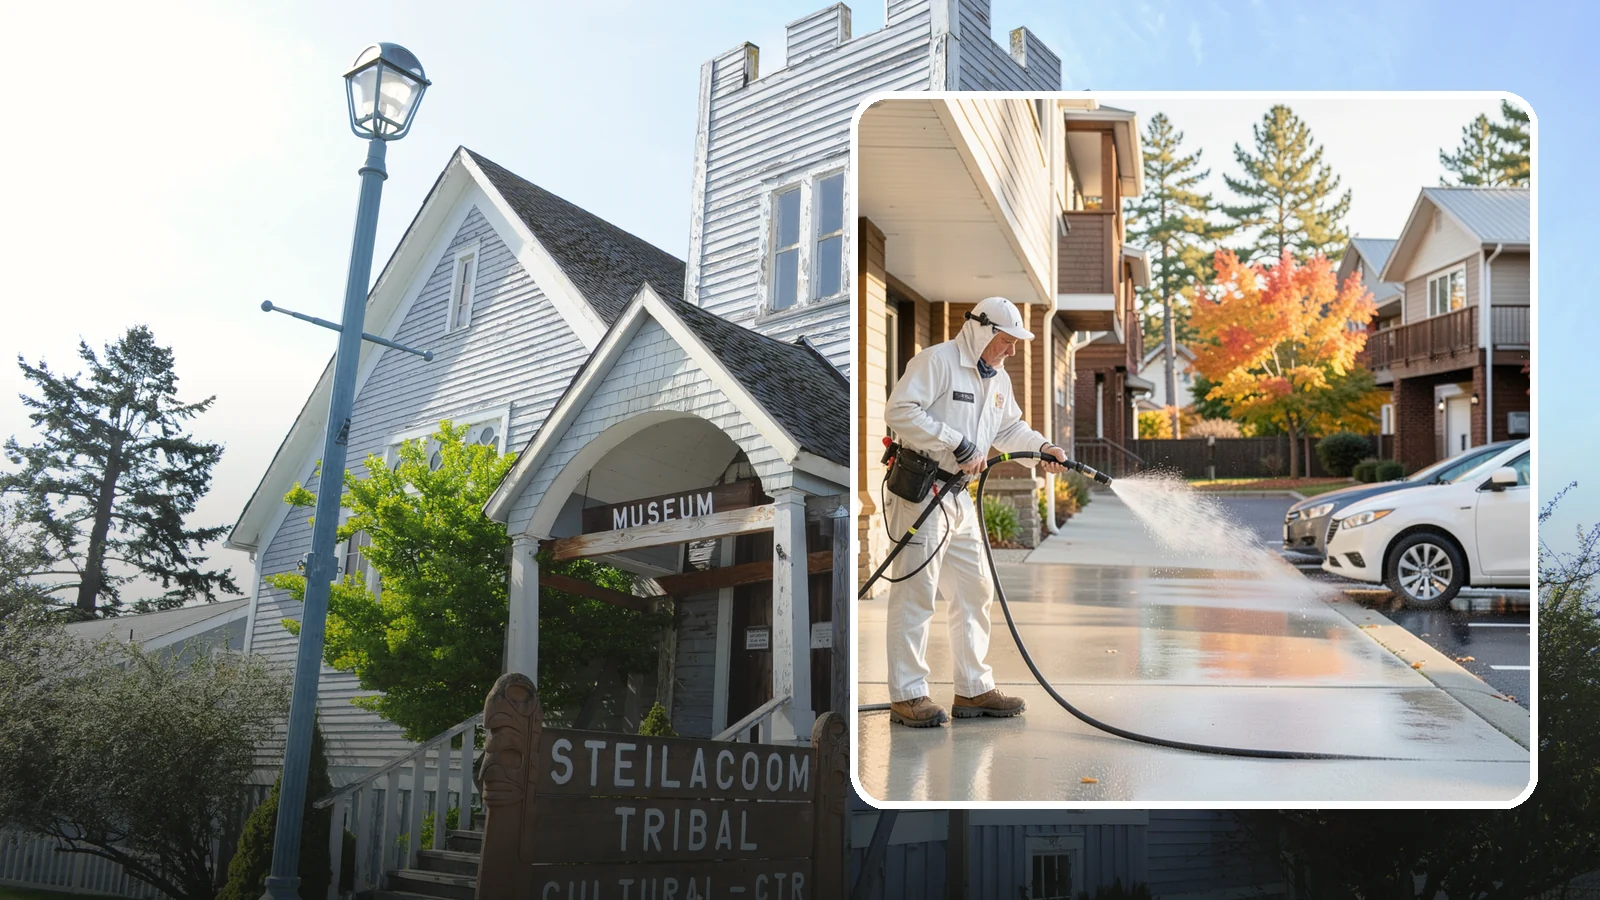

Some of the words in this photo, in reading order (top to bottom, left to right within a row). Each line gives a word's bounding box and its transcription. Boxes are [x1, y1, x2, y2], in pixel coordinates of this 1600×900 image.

[613, 491, 713, 531] MUSEUM
[550, 738, 809, 793] STEILACOOM
[615, 806, 757, 852] TRIBAL
